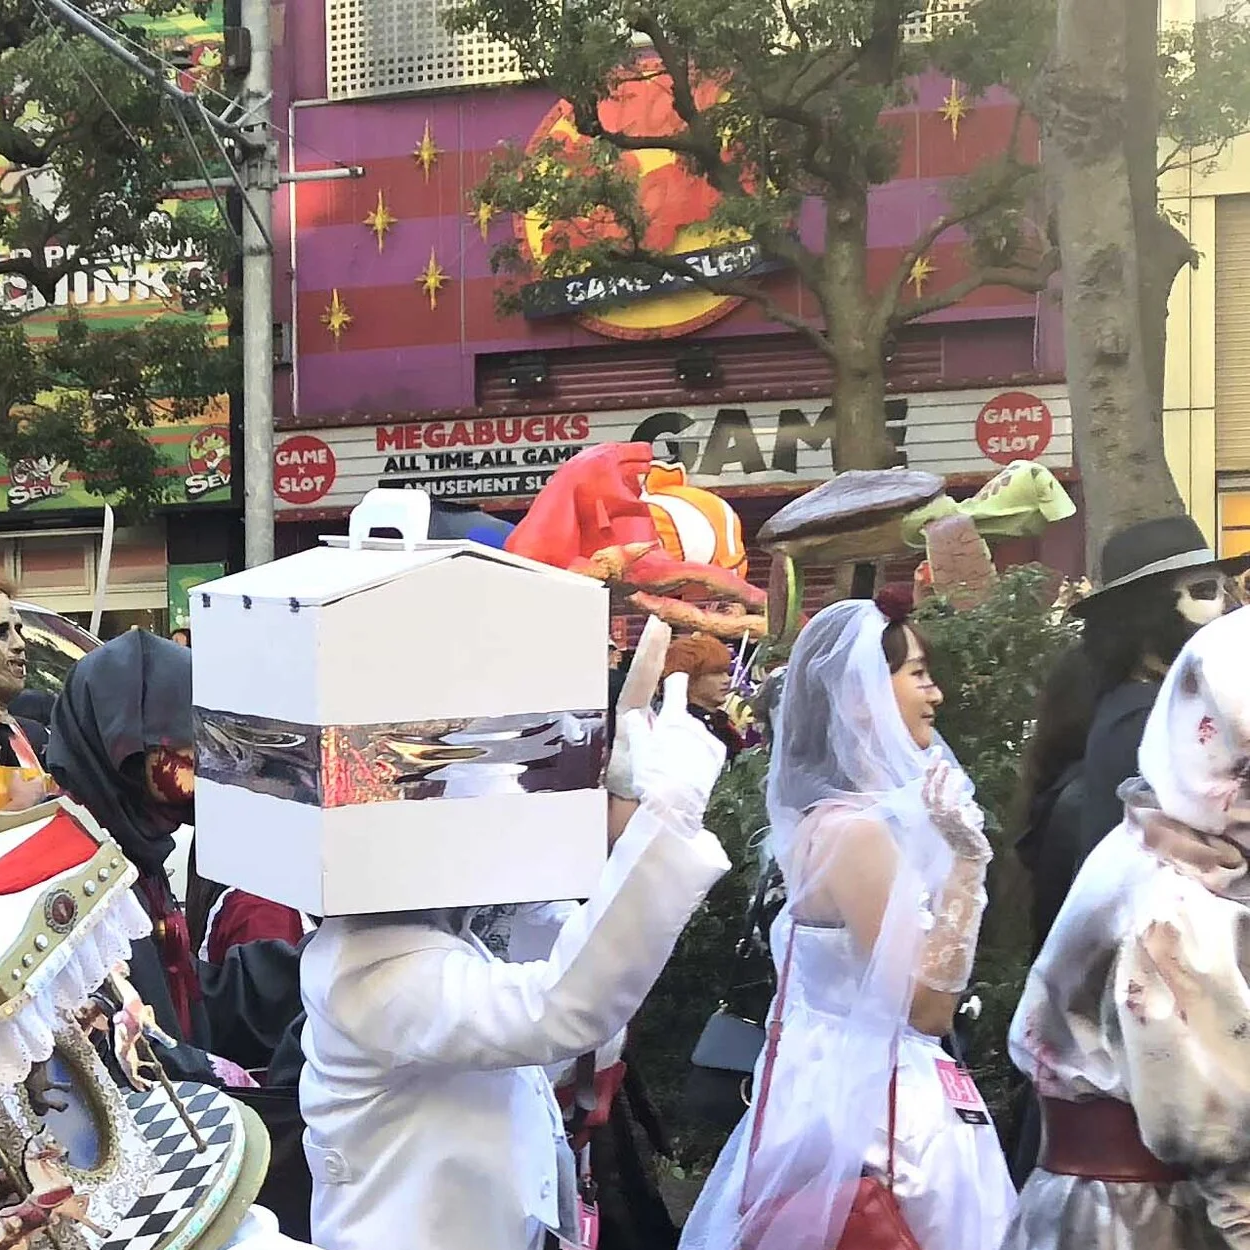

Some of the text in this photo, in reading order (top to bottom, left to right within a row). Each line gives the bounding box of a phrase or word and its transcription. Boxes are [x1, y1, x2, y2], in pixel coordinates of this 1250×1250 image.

[983, 405, 1044, 425] GAME
[376, 414, 590, 452] MEGABUCKS
[987, 434, 1040, 454] SLOT
[275, 448, 328, 467] GAME
[383, 454, 421, 473] ALL
[278, 475, 326, 494] SLOT
